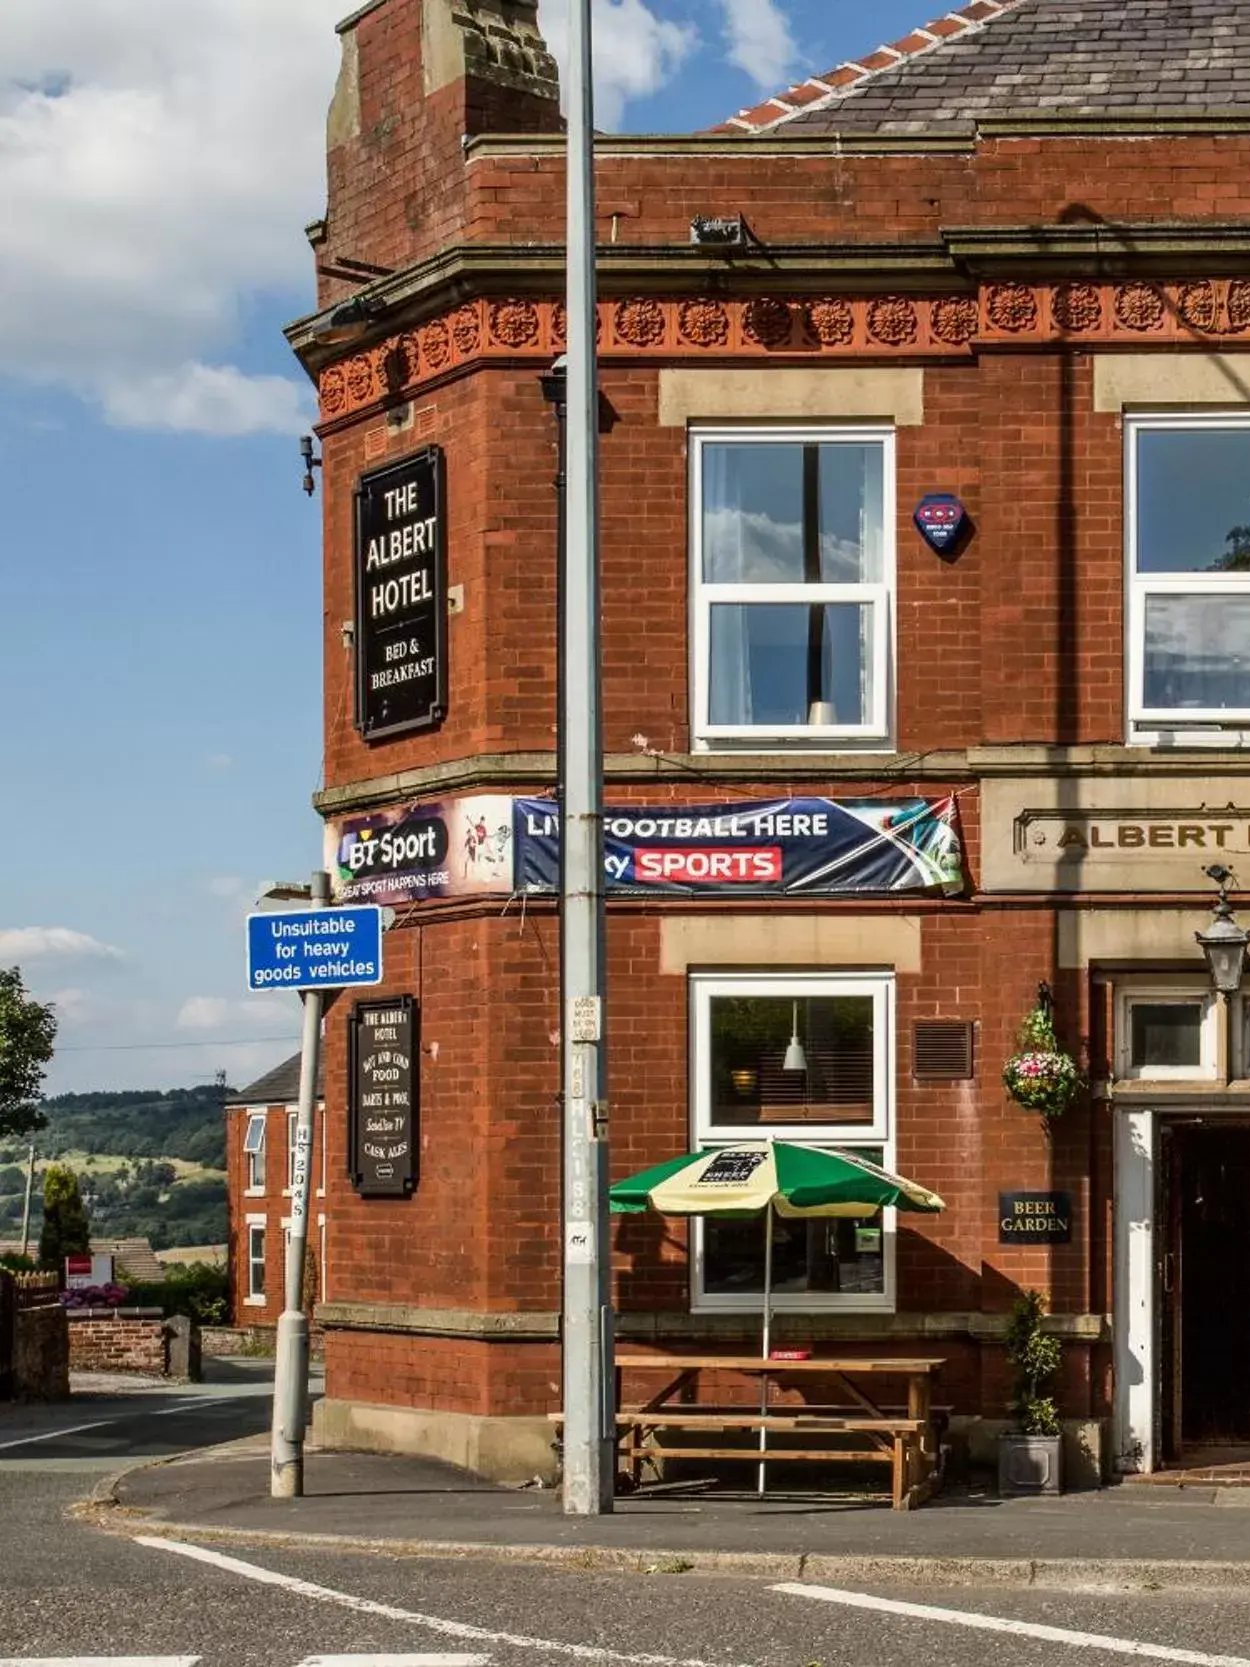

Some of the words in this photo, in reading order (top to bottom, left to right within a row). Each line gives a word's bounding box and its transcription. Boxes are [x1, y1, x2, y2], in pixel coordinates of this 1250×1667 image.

[385, 481, 418, 520] THE
[367, 517, 437, 572] ALBERT
[372, 568, 433, 617] HOTEL
[386, 641, 408, 662] BED
[409, 638, 420, 655] &
[371, 657, 435, 690] BREAKFAST
[527, 814, 559, 836] LI
[755, 813, 828, 837] HERE
[1057, 824, 1234, 848] ALBERT
[350, 838, 379, 869] BT
[380, 826, 437, 868] Sport
[640, 851, 776, 878] SPORTS
[271, 917, 356, 938] Unsuitable
[275, 942, 297, 959] for
[304, 940, 349, 957] heavy
[254, 963, 301, 984] goods
[309, 960, 375, 979] vehicles
[374, 1028, 397, 1041] HOTEL
[372, 1068, 400, 1082] FOOD
[1013, 1201, 1056, 1214] BEER
[1001, 1217, 1069, 1231] GARDEN
